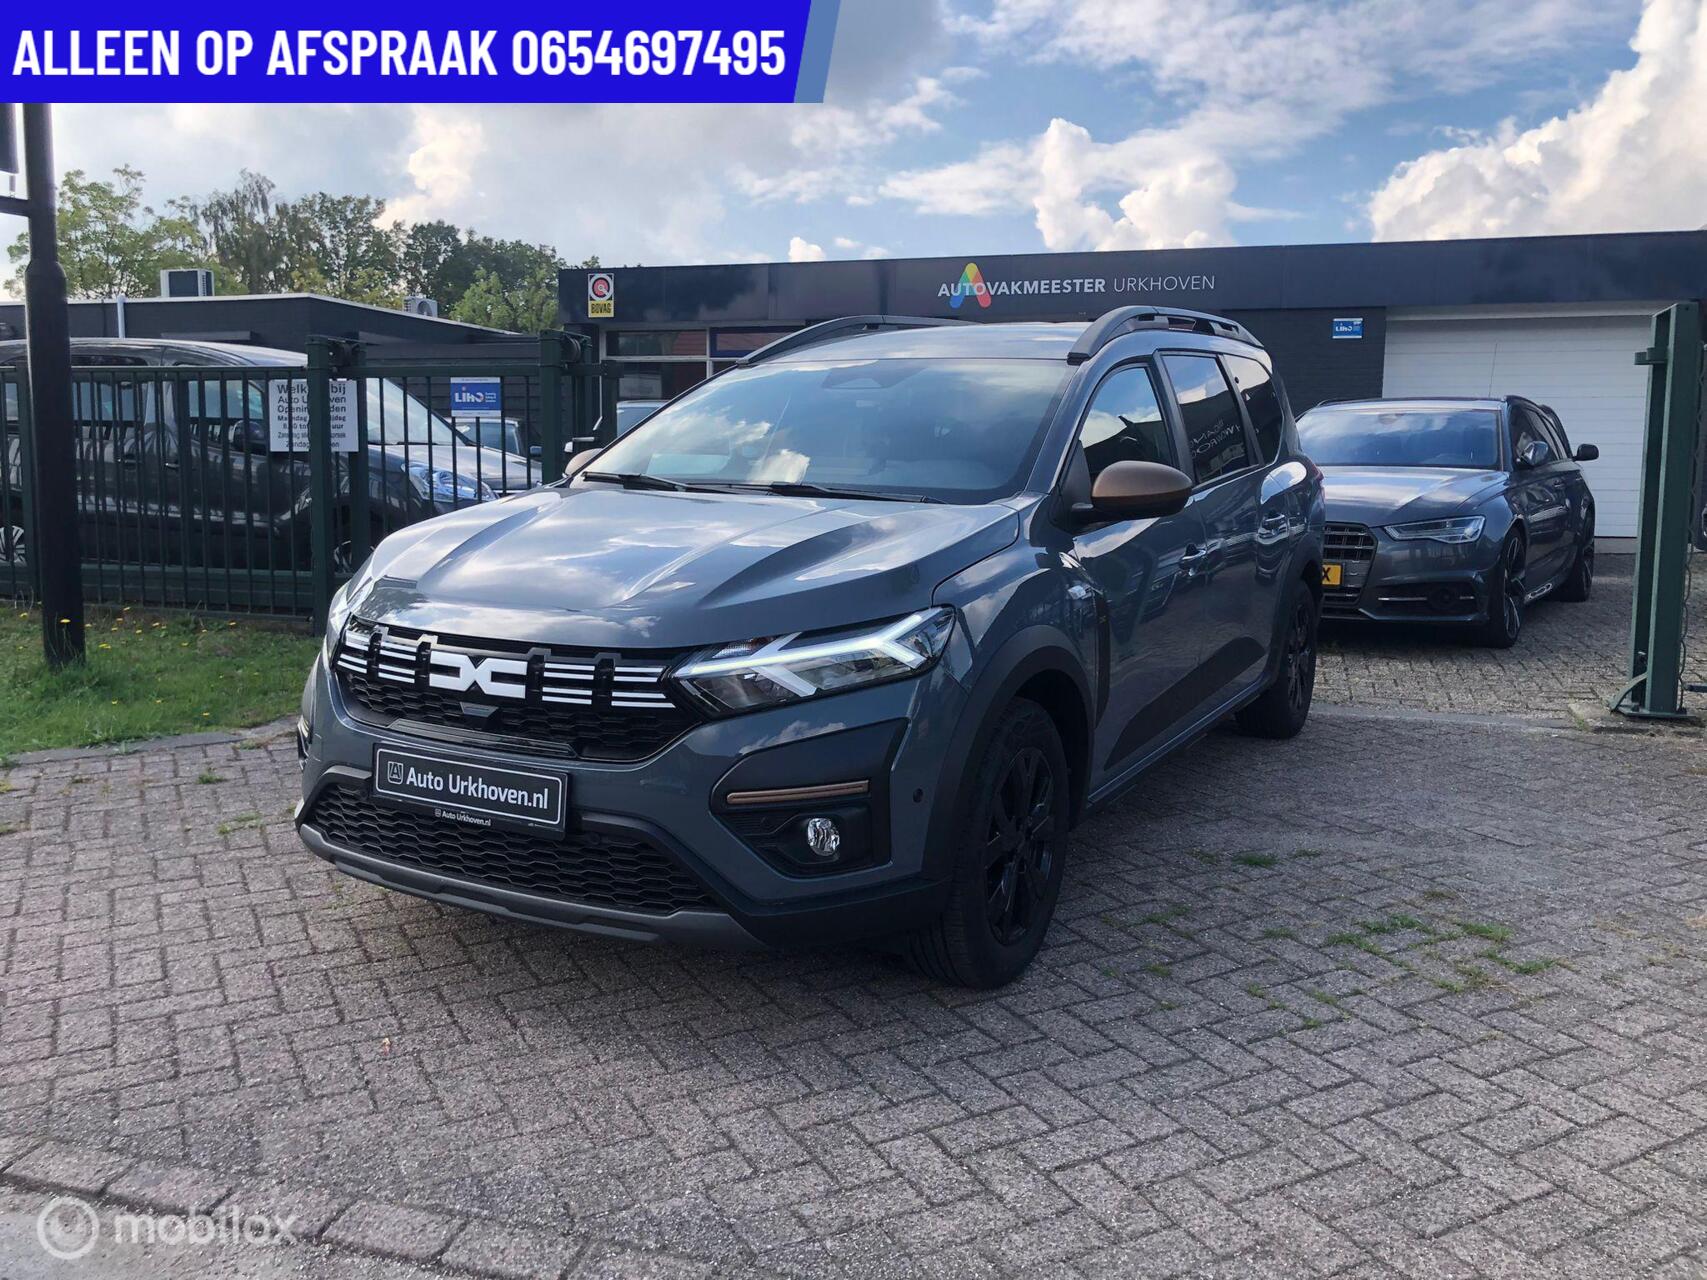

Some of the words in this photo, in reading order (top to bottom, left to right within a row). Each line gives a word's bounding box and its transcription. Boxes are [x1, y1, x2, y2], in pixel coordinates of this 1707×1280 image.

[937, 278, 1106, 297] AUTOVAKMEESTER
[1113, 275, 1216, 293] URKHOVEN
[331, 383, 346, 395] bij
[406, 767, 444, 791] Auto
[448, 774, 548, 809] Urkhoven.nl
[441, 810, 456, 820] Auto
